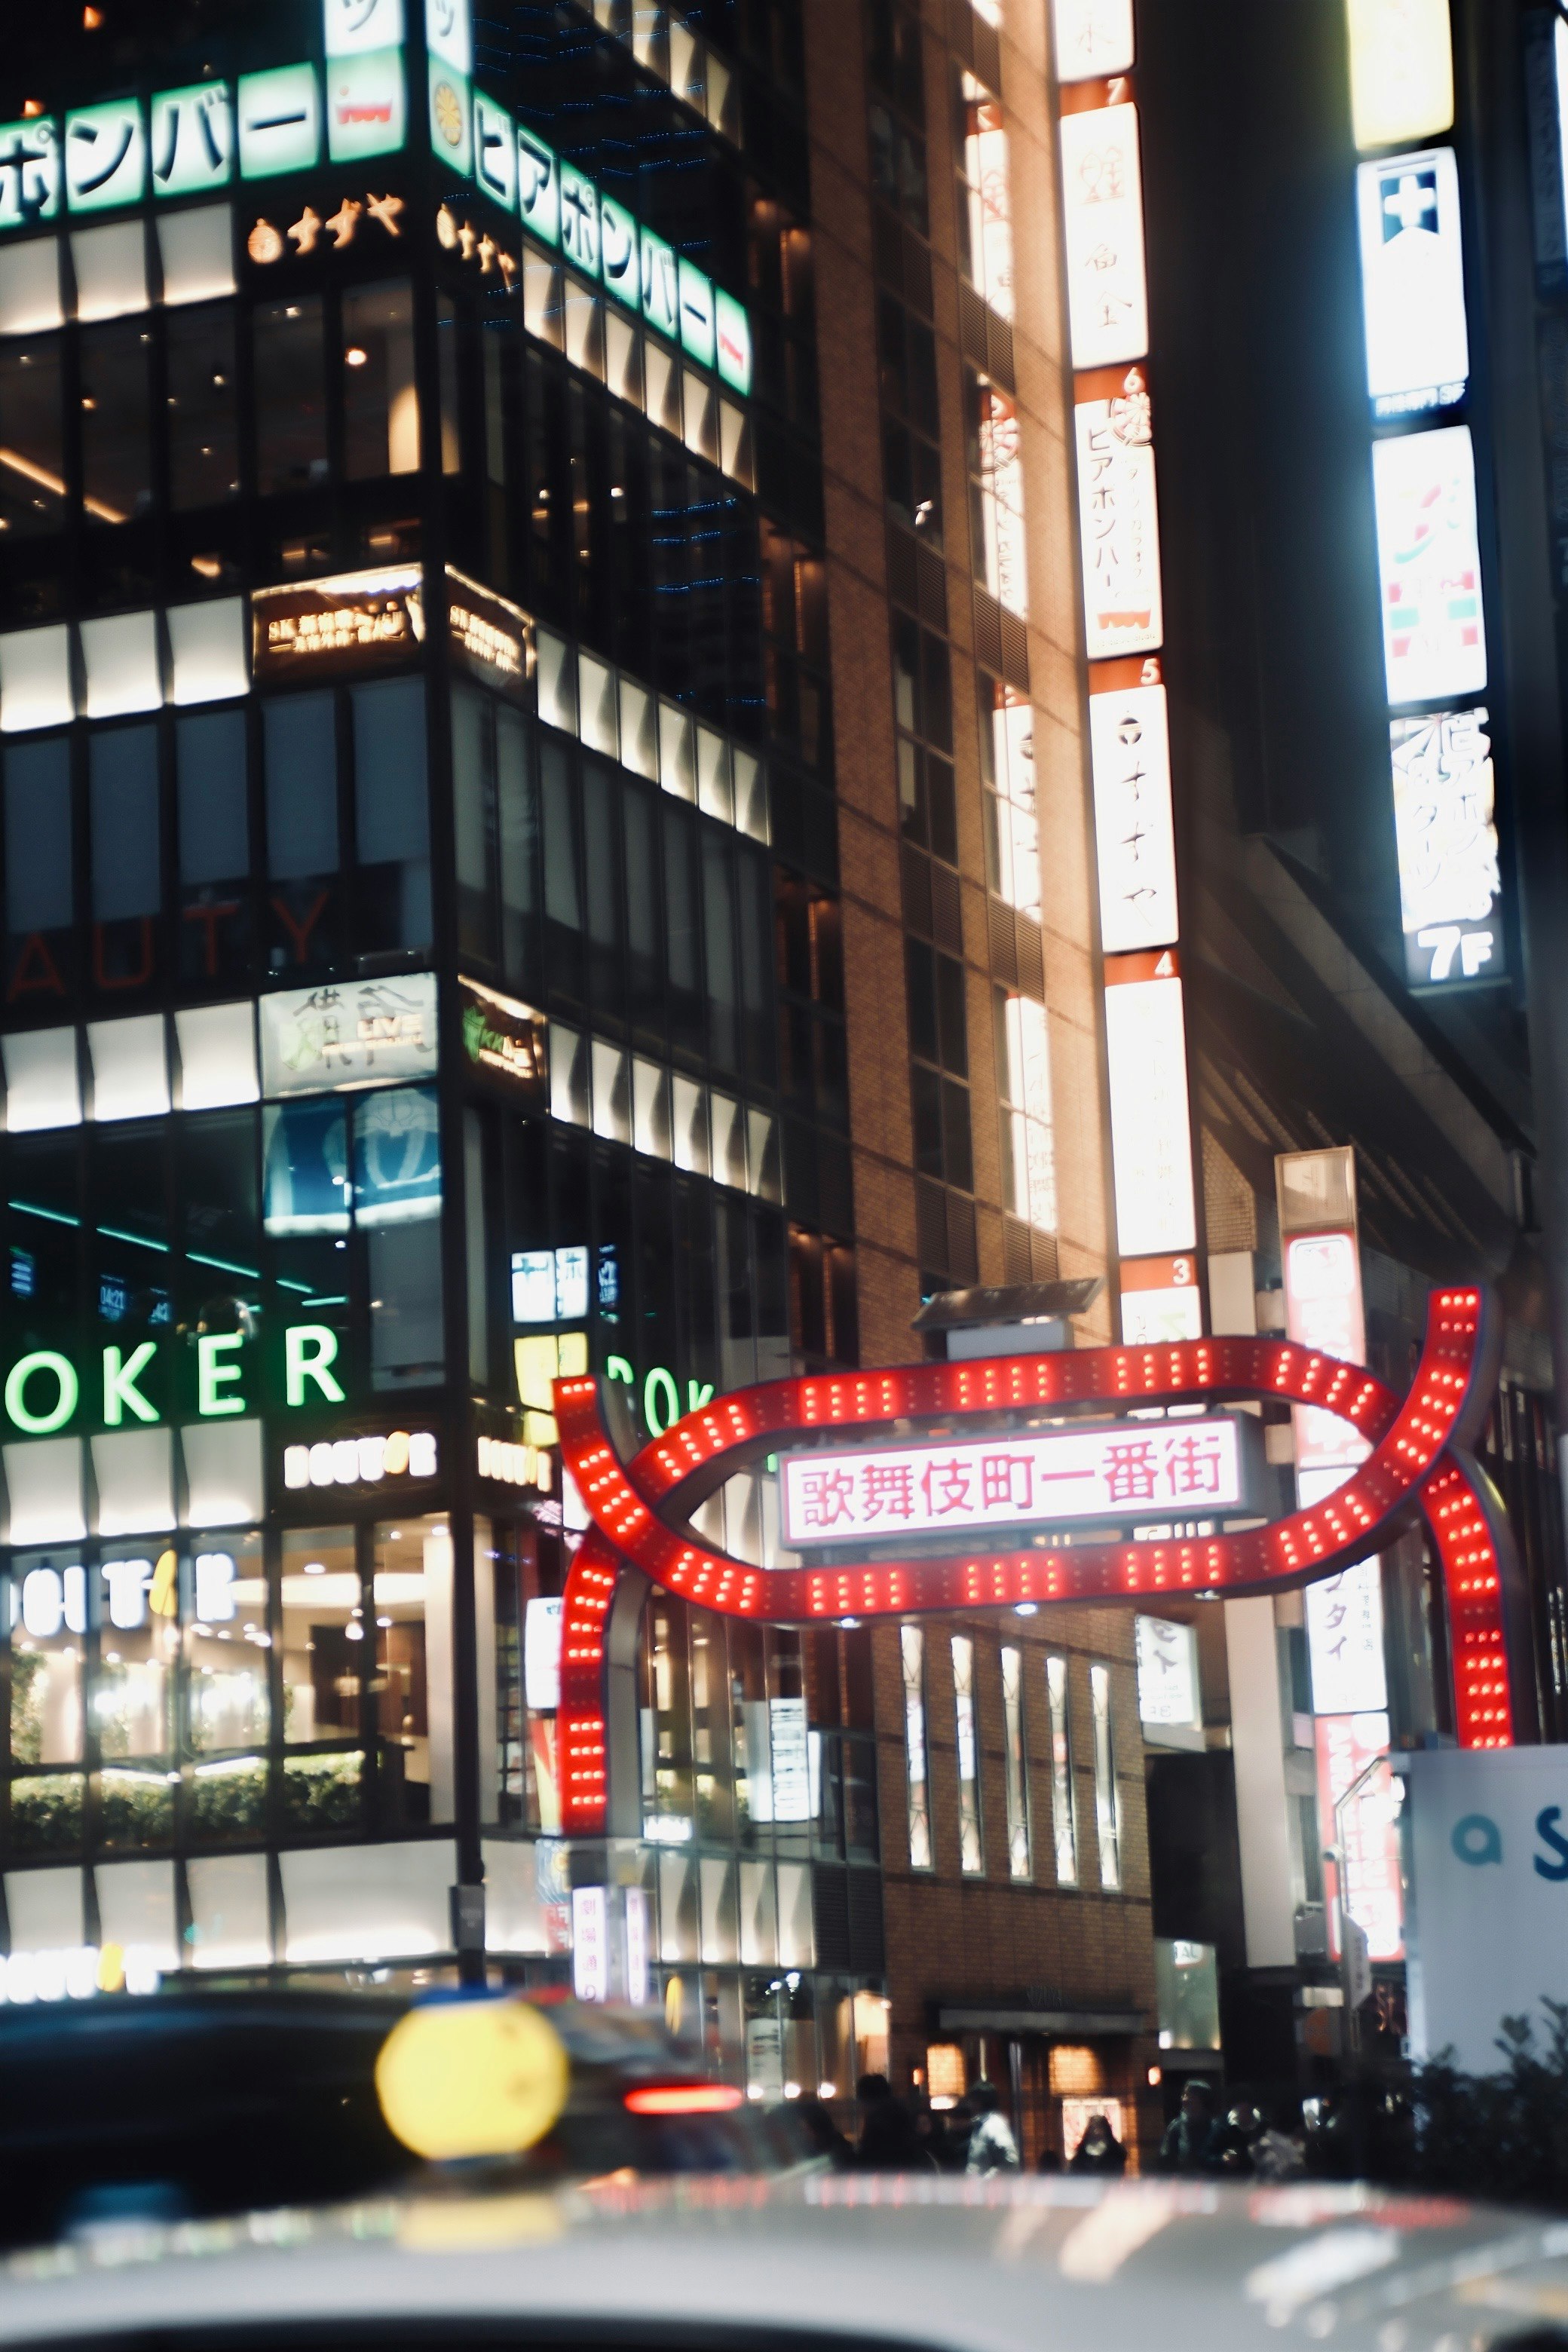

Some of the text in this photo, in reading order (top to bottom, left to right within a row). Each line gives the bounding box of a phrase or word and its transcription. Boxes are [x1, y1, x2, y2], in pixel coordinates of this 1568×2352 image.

[476, 106, 708, 328] ビアポンバー
[1123, 367, 1144, 394] 6
[1141, 658, 1161, 685] 5
[1155, 951, 1173, 977] 4
[1418, 926, 1493, 979] 7F
[357, 1013, 424, 1040] LIVE
[1173, 1259, 1190, 1285] 3
[5, 1325, 345, 1433] OKER
[801, 1435, 1220, 1527] 歌舞伎町一番街
